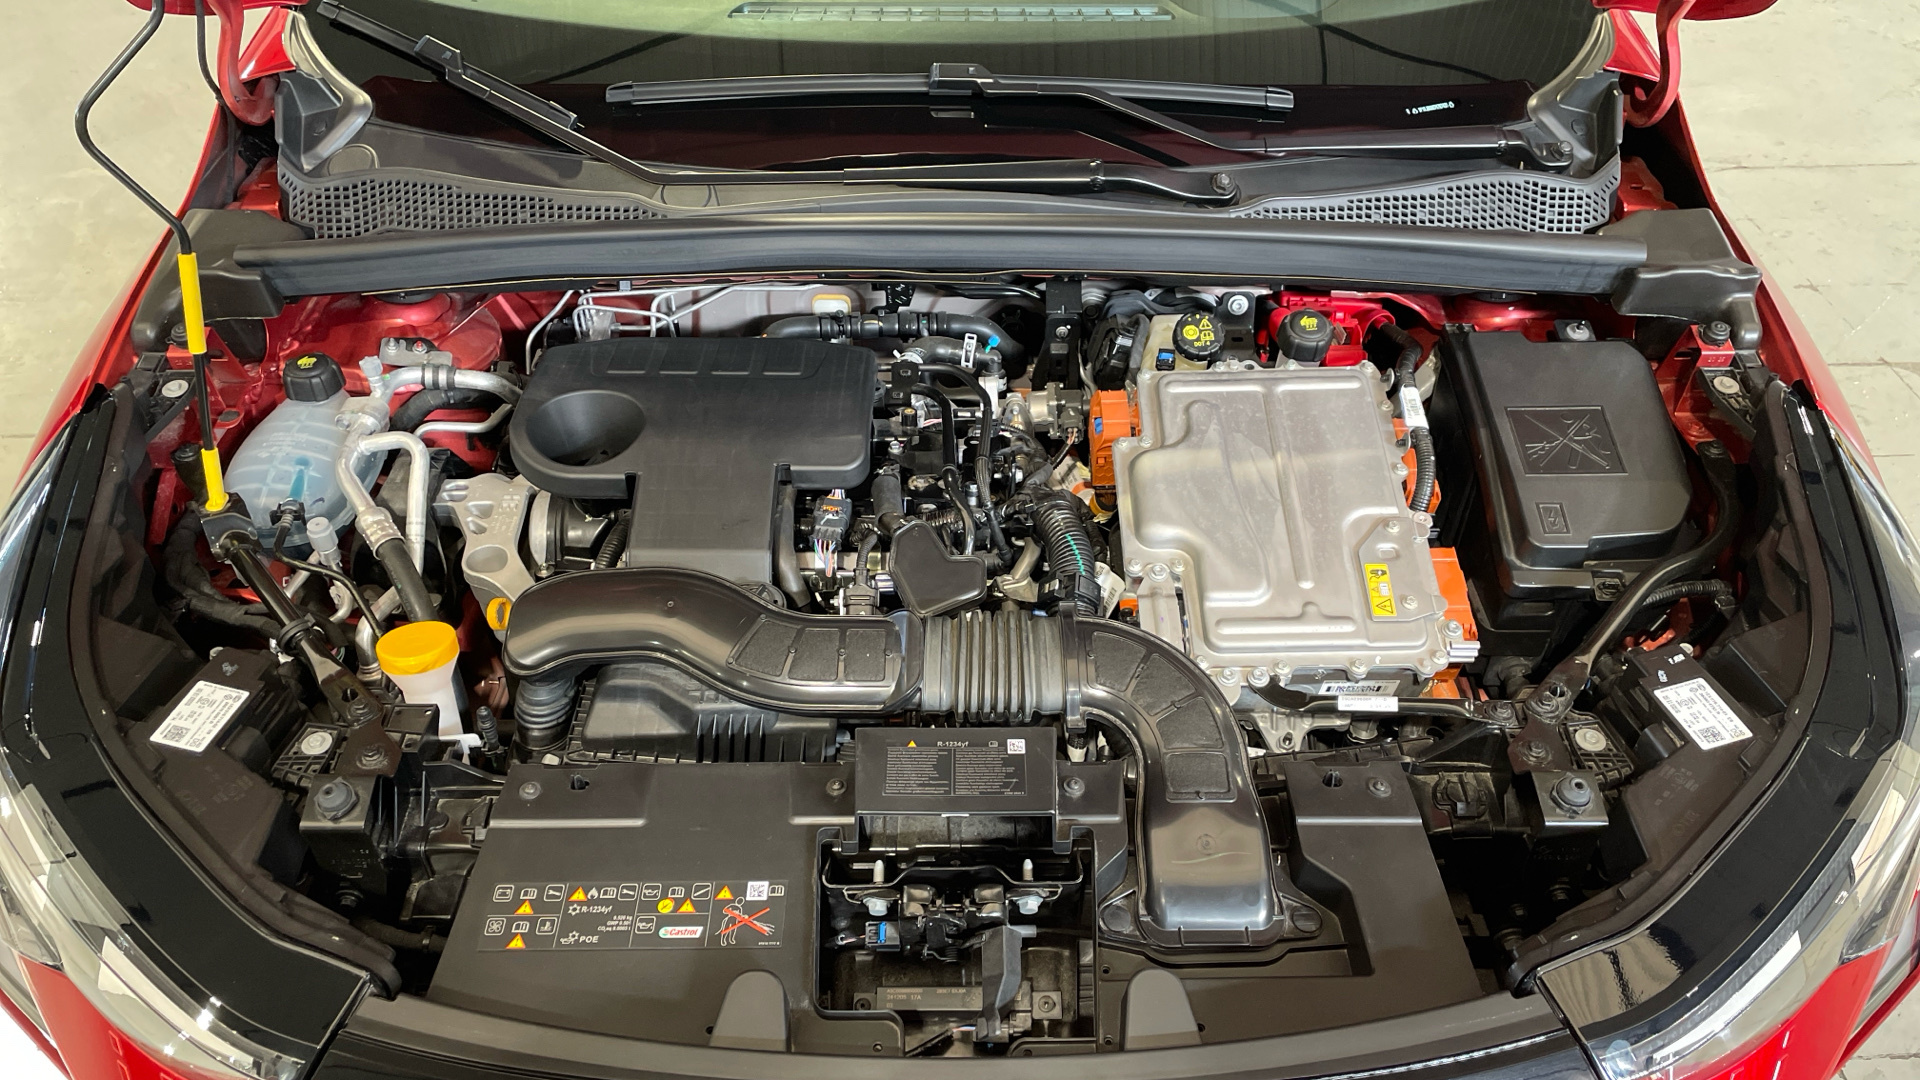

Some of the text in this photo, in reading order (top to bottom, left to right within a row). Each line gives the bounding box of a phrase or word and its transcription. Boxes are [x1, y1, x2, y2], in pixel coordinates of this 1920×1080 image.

[937, 741, 969, 749] R-1234yf
[581, 905, 613, 914] R-1234yf
[669, 928, 699, 936] Castrol
